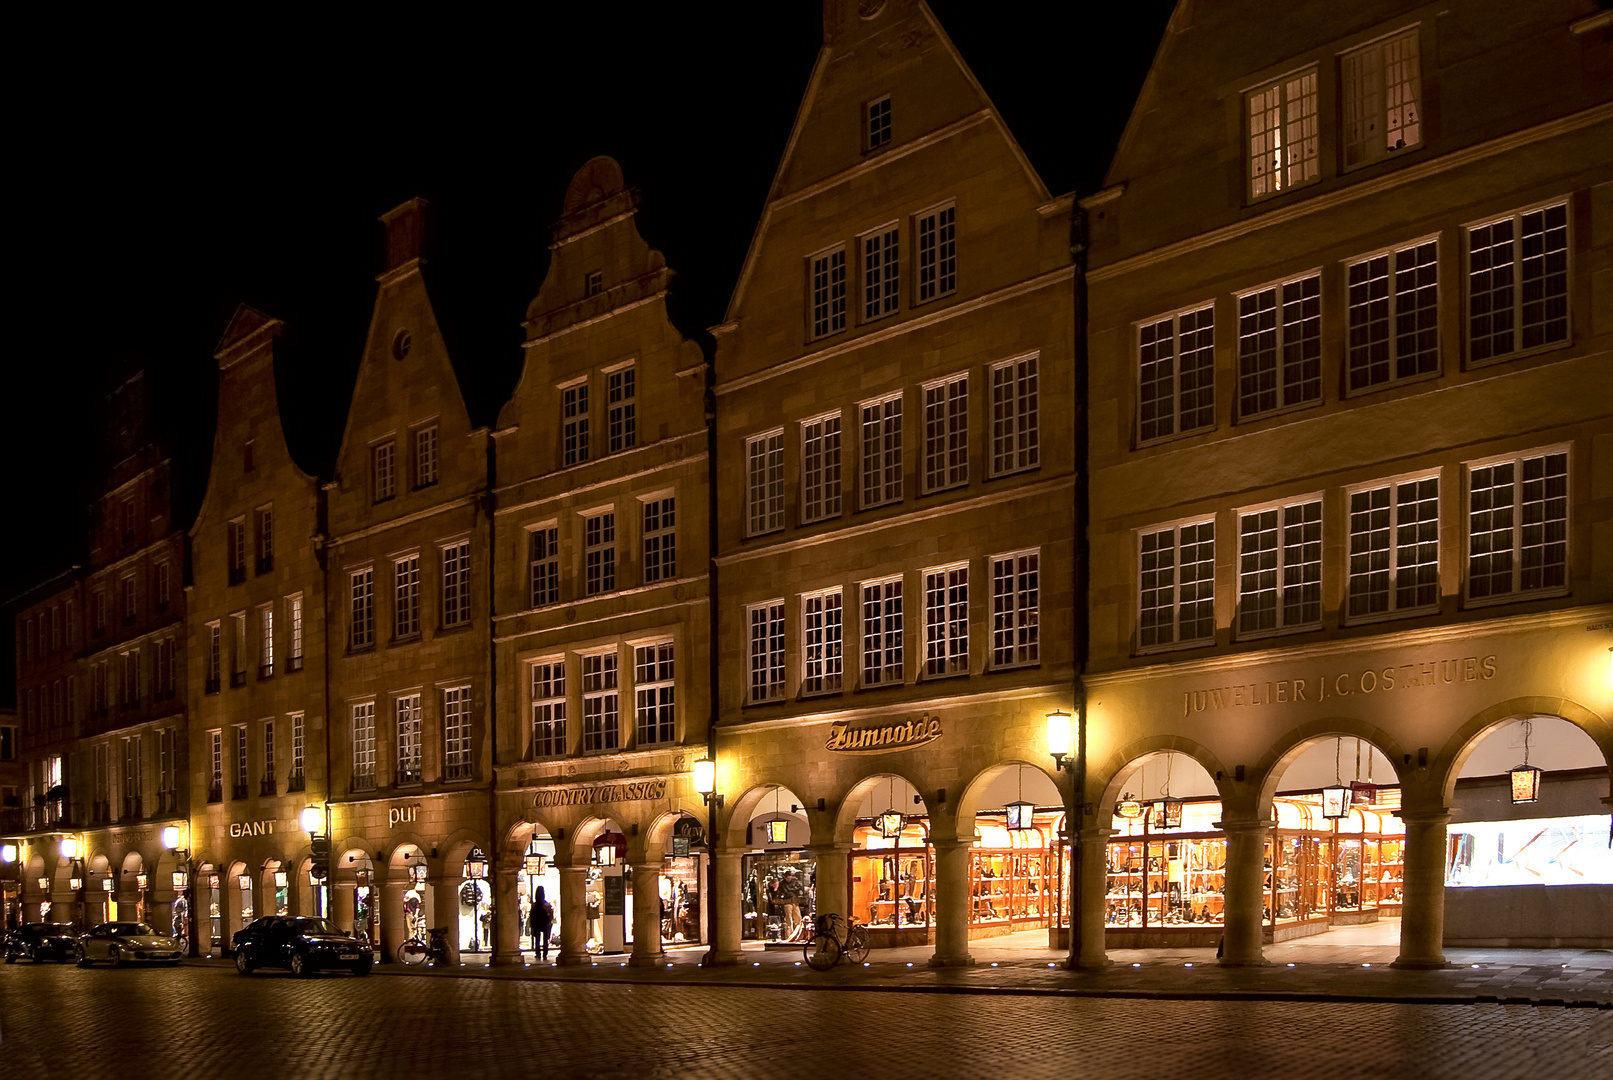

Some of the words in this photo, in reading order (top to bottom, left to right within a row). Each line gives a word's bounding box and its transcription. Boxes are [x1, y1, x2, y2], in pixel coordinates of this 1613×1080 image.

[1183, 678, 1307, 718] JUWELIER
[533, 787, 597, 808] COUNTRY
[600, 780, 664, 803] CLASSICS
[389, 803, 420, 828] pur
[230, 821, 276, 837] GANT
